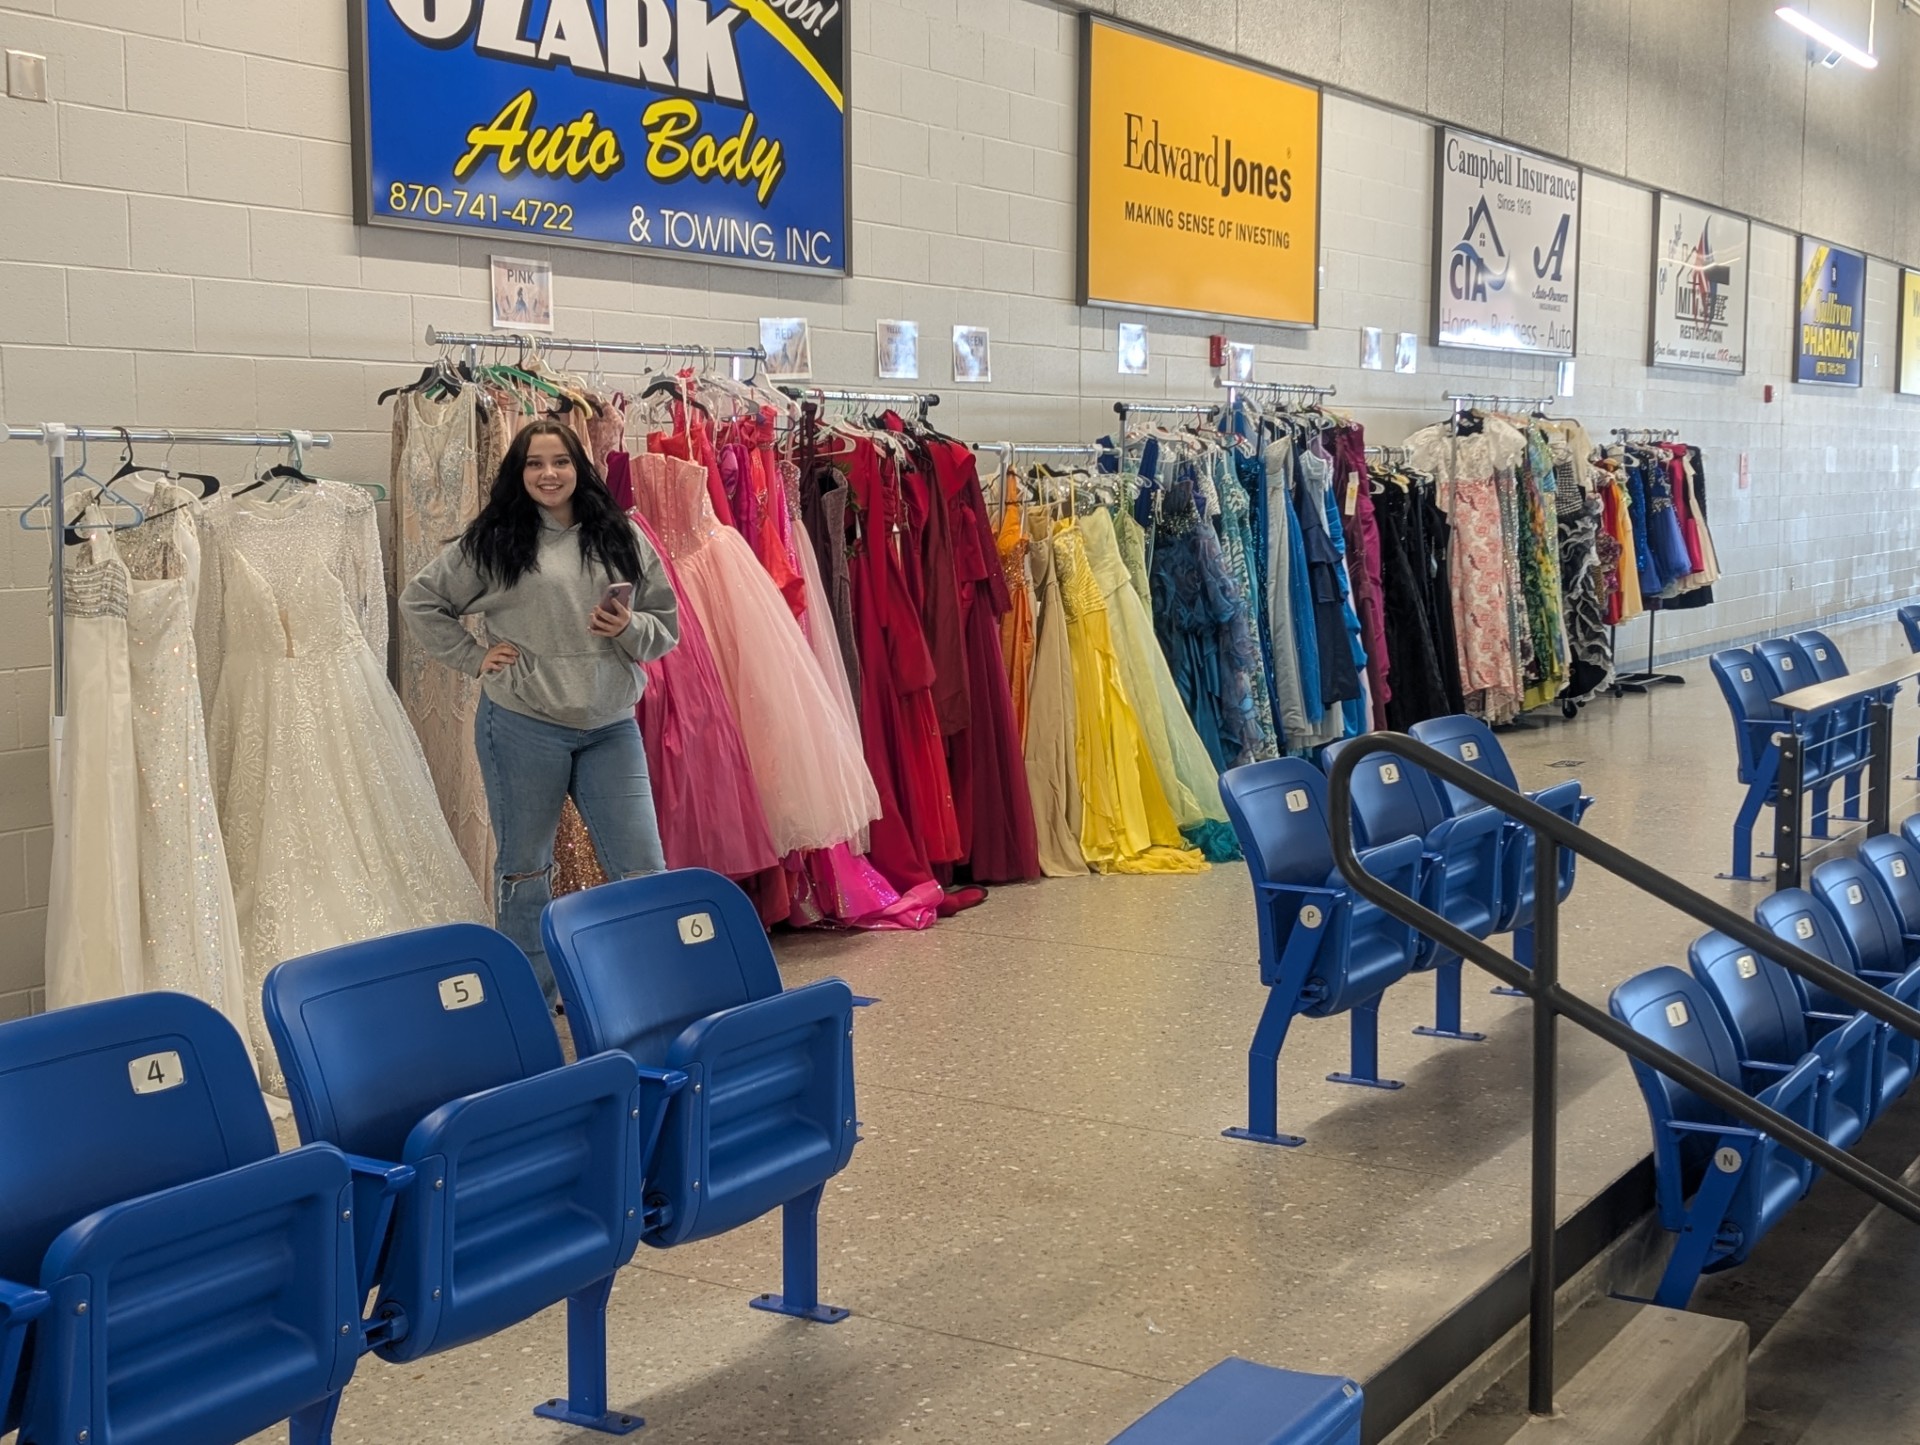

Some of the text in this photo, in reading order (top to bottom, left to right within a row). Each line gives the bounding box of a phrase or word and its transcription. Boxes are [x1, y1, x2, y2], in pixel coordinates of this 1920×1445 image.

[768, 0, 839, 37] os!
[454, 89, 782, 202] Auto Body
[1123, 112, 1292, 203] Edward Jones
[1446, 138, 1577, 202] Campbell Insurance
[389, 182, 574, 231] 870-741-4722
[1496, 193, 1516, 213] Since
[629, 205, 832, 265] & TOWING, INC
[1124, 201, 1290, 250] MAKING SENSE OF INVESTING
[506, 268, 535, 285] PINK
[1449, 252, 1488, 303] CIA
[775, 327, 793, 340] RED
[1547, 320, 1572, 350] Auto
[1802, 325, 1860, 360] PHARMACY
[1464, 745, 1474, 759] 3
[1384, 766, 1395, 781] 2
[1292, 793, 1301, 808] 1
[690, 918, 703, 938] 6
[1306, 910, 1316, 922] P
[453, 980, 469, 1004] 5
[147, 1059, 166, 1085] 4
[1723, 1153, 1735, 1167] N
